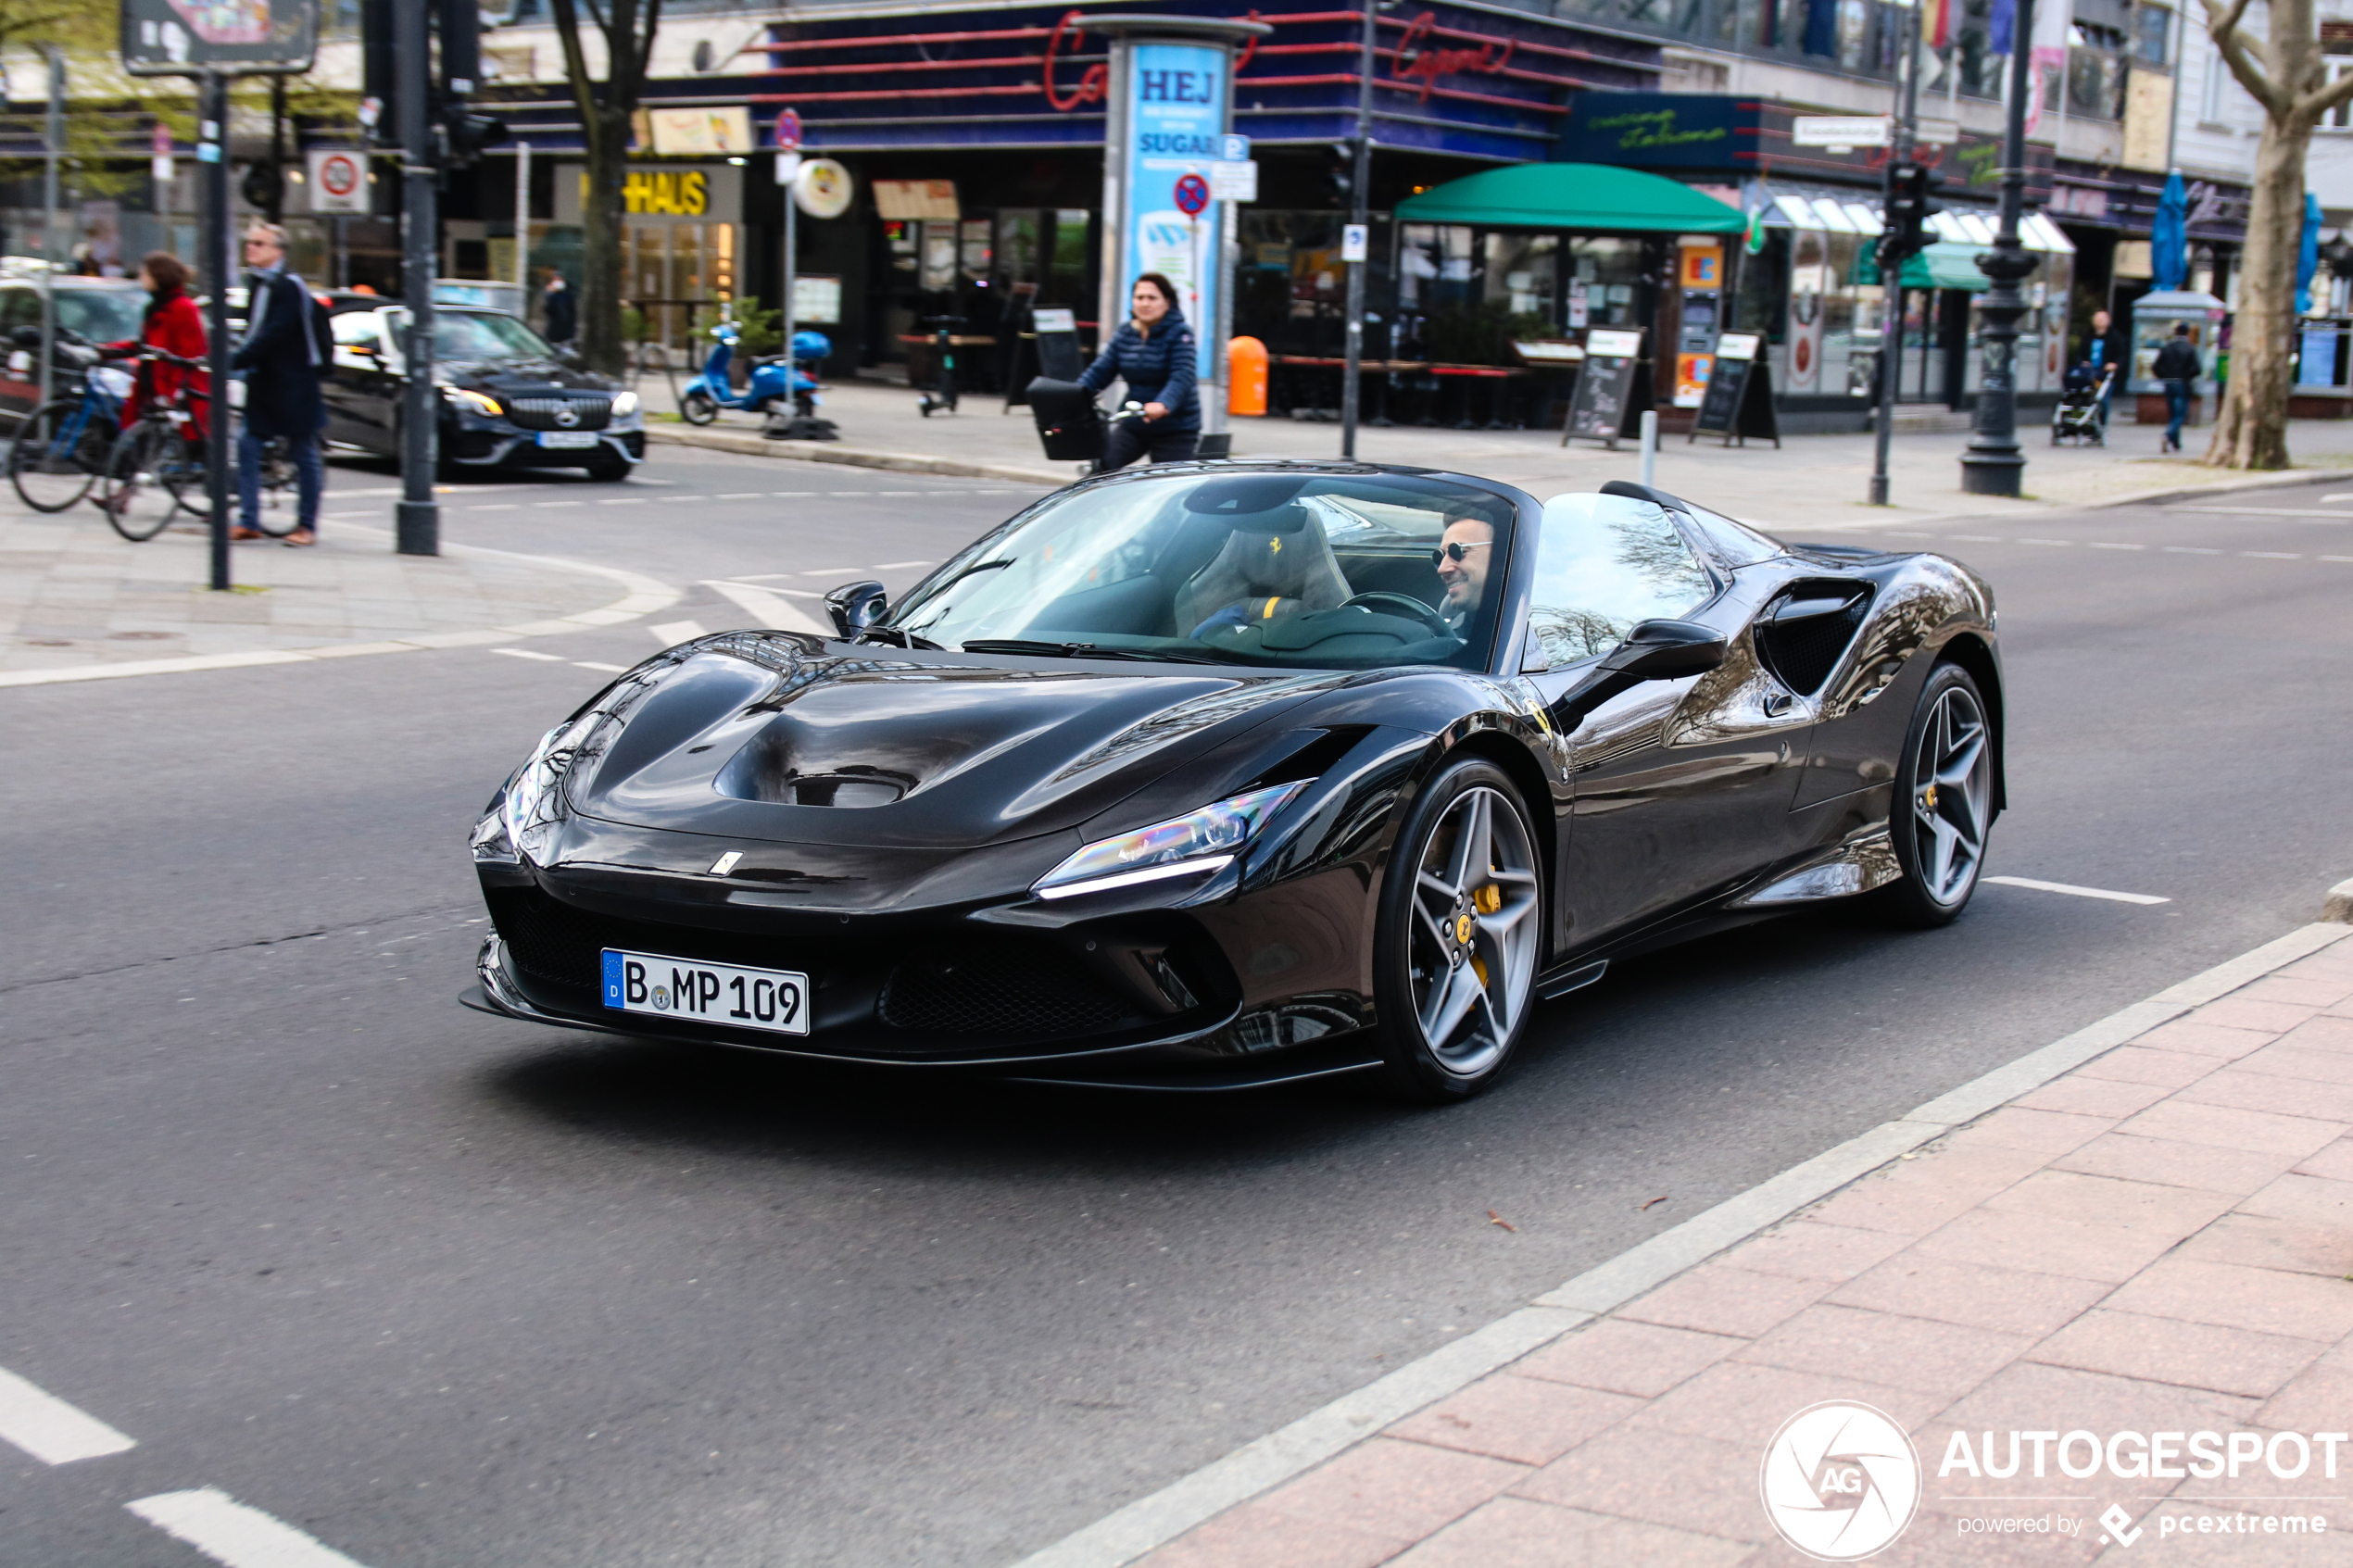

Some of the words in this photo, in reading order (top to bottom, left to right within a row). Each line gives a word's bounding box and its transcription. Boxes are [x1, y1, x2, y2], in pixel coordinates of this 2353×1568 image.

[1140, 70, 1214, 104] HEJ
[610, 985, 619, 998] D
[625, 960, 648, 1004] B
[673, 967, 721, 1012] MP
[729, 974, 801, 1024] 109
